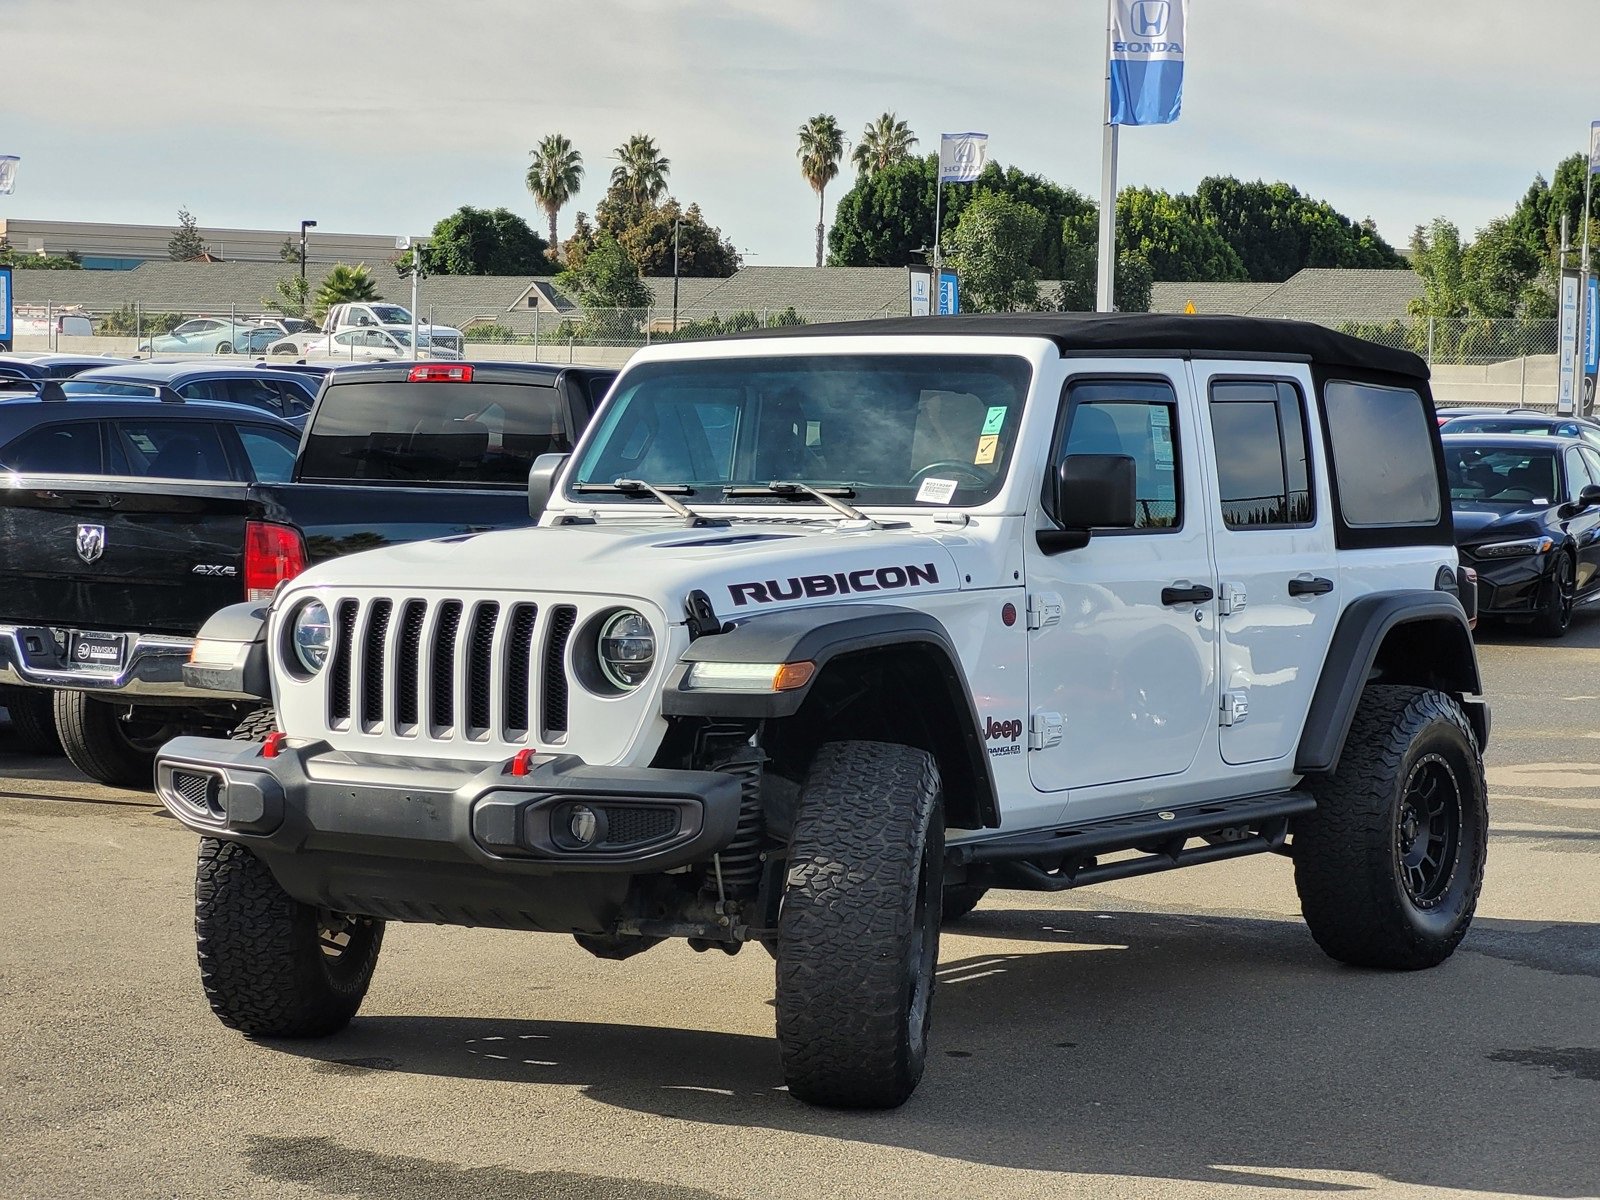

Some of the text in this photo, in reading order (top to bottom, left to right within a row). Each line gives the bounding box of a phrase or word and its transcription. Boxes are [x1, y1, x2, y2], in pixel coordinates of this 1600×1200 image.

[1112, 41, 1184, 54] HONDA
[940, 281, 948, 315] SION
[727, 562, 940, 607] RUBICON
[91, 645, 118, 654] ENVISION
[982, 716, 1022, 742] Jeep
[988, 745, 1021, 754] RANGLER
